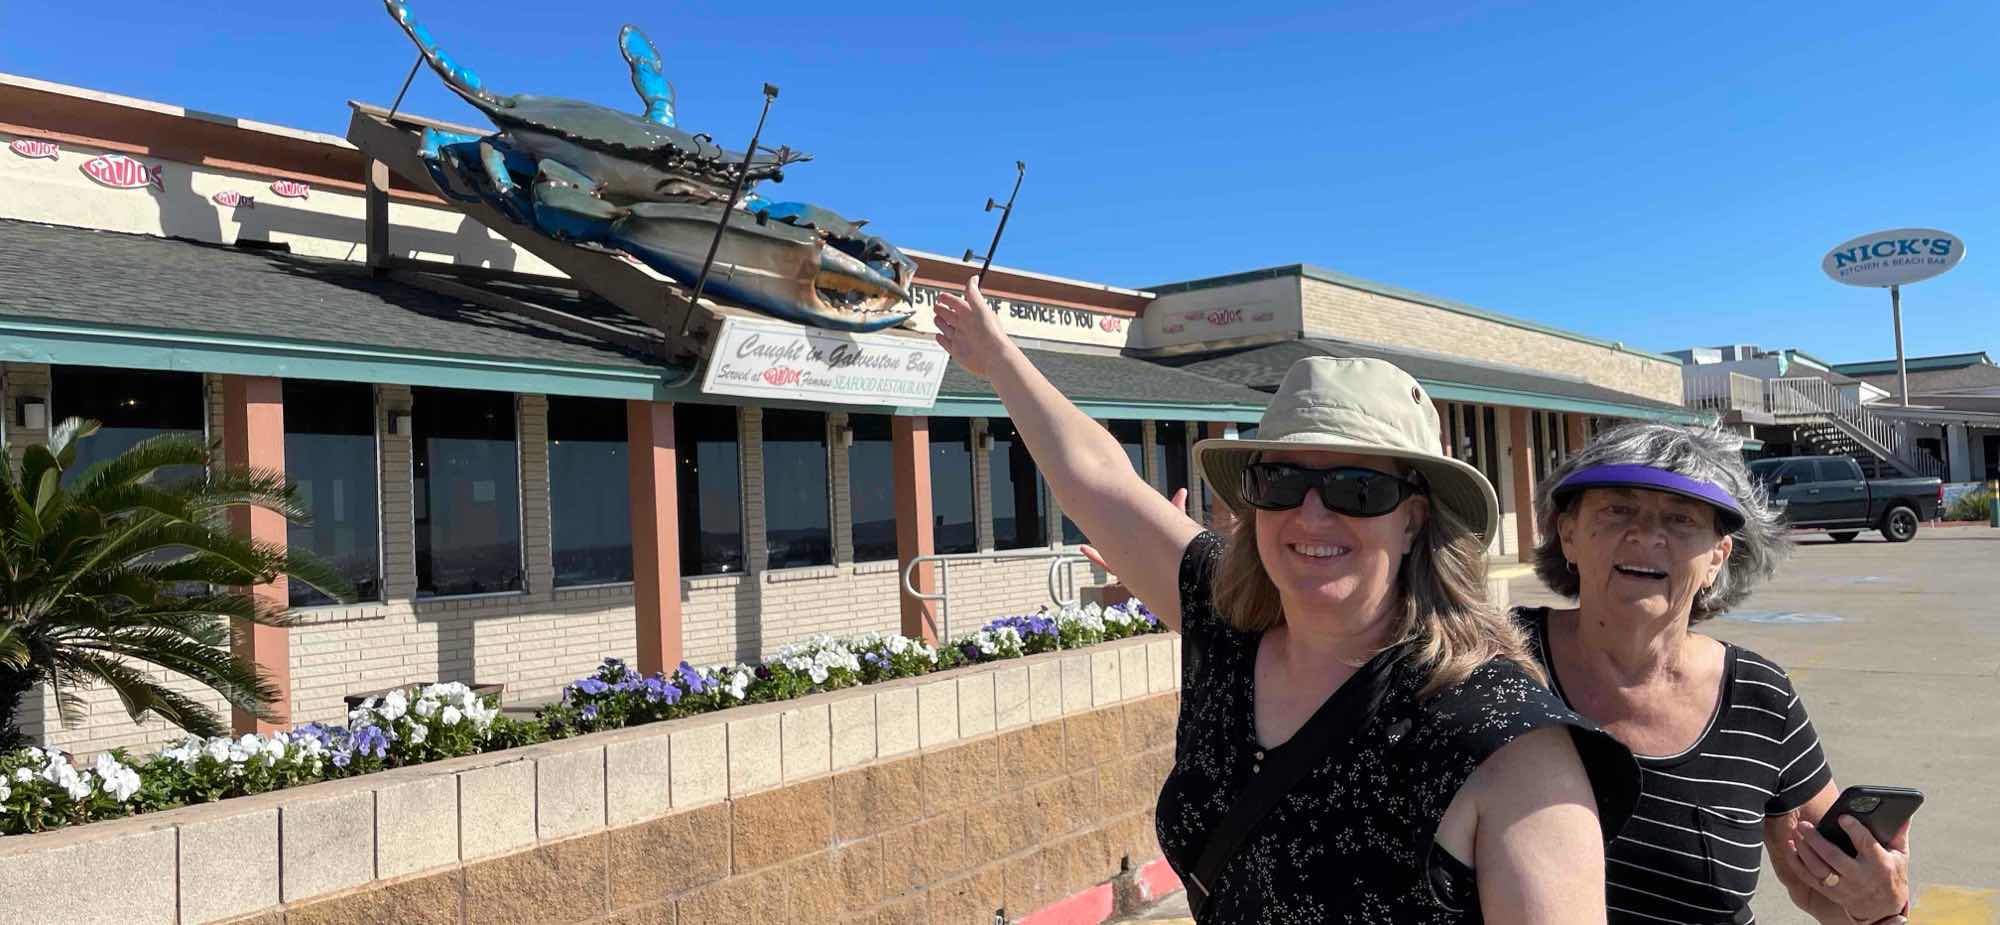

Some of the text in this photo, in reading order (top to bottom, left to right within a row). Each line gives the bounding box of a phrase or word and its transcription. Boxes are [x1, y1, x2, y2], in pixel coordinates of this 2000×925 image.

[1833, 238, 1952, 269] NICK'S
[1841, 262, 1880, 277] KITCHEN
[1892, 257, 1925, 266] BEACH
[1928, 257, 1946, 266] BAR
[1009, 303, 1057, 324] SERVICE
[1057, 309, 1072, 326] TO
[1074, 311, 1094, 329] YOU
[736, 333, 936, 377] Caught in Galveston Bay
[717, 363, 751, 381] Served
[832, 375, 878, 392] SEAFOOD
[877, 378, 937, 397] RESTAURANT
